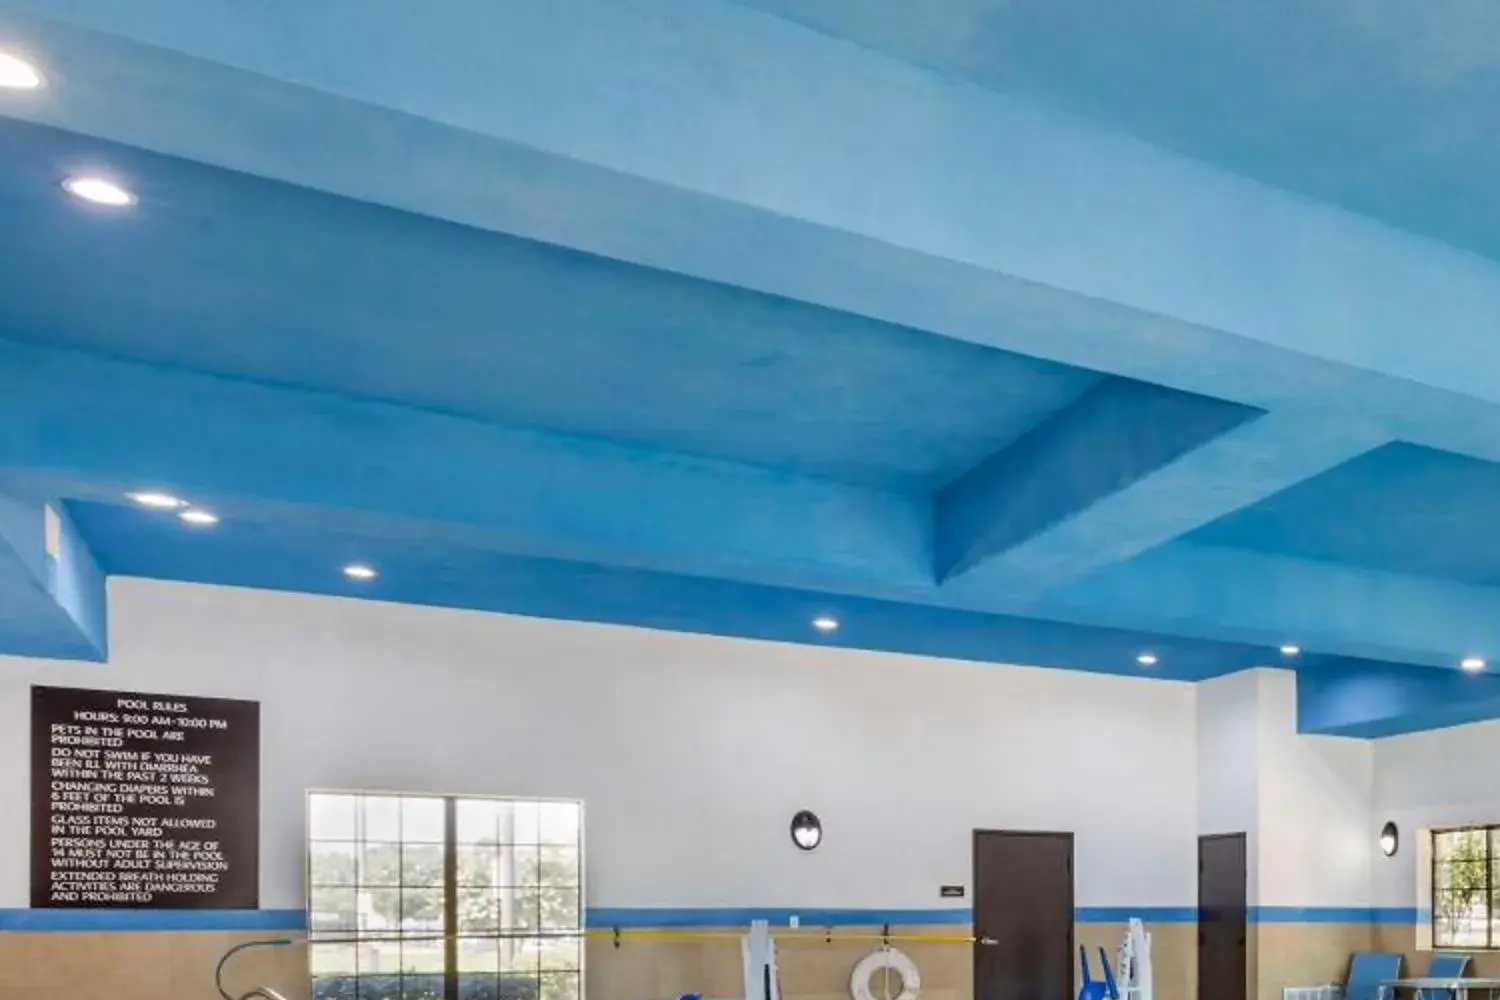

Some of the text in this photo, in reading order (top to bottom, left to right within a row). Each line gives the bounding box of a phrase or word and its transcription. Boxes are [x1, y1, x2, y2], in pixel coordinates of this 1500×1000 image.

[117, 699, 187, 713] POOL RULES
[74, 711, 120, 723] HOURS:
[122, 714, 149, 724] 9:00
[209, 720, 227, 729] PM
[51, 723, 185, 740] PETS IN THE POOL ARE
[51, 735, 123, 747] PROHIBITED
[51, 747, 212, 764] DO NOT SWIM IF YOU HAVE
[51, 758, 82, 768] BEEN
[85, 760, 100, 769] ILL
[105, 761, 137, 771] WITH
[51, 768, 209, 784] WITHIN THE PAST 2 WEEKS
[51, 780, 214, 796] CHANGING DIAPERS WITHIN
[51, 792, 184, 805] 6 FEET OF THE POOL IS
[51, 801, 123, 813] PROHIBITED
[51, 814, 216, 829] GLASS ITEMS NOT ALLOWED
[51, 826, 162, 836] IN THE POOL YARD
[51, 838, 219, 850] PERSONS UNDER THE AGE OF
[53, 849, 224, 860] 14 MUST NOT BE IN THE POOL
[51, 858, 229, 870] WITHOUT ADULT SUPERVISION
[51, 871, 218, 882] EXTENDED BREATH HOLDING
[51, 882, 216, 892] ACTIVITIES ARE DANGEROUS
[51, 892, 152, 901] AND PROHIBITED
